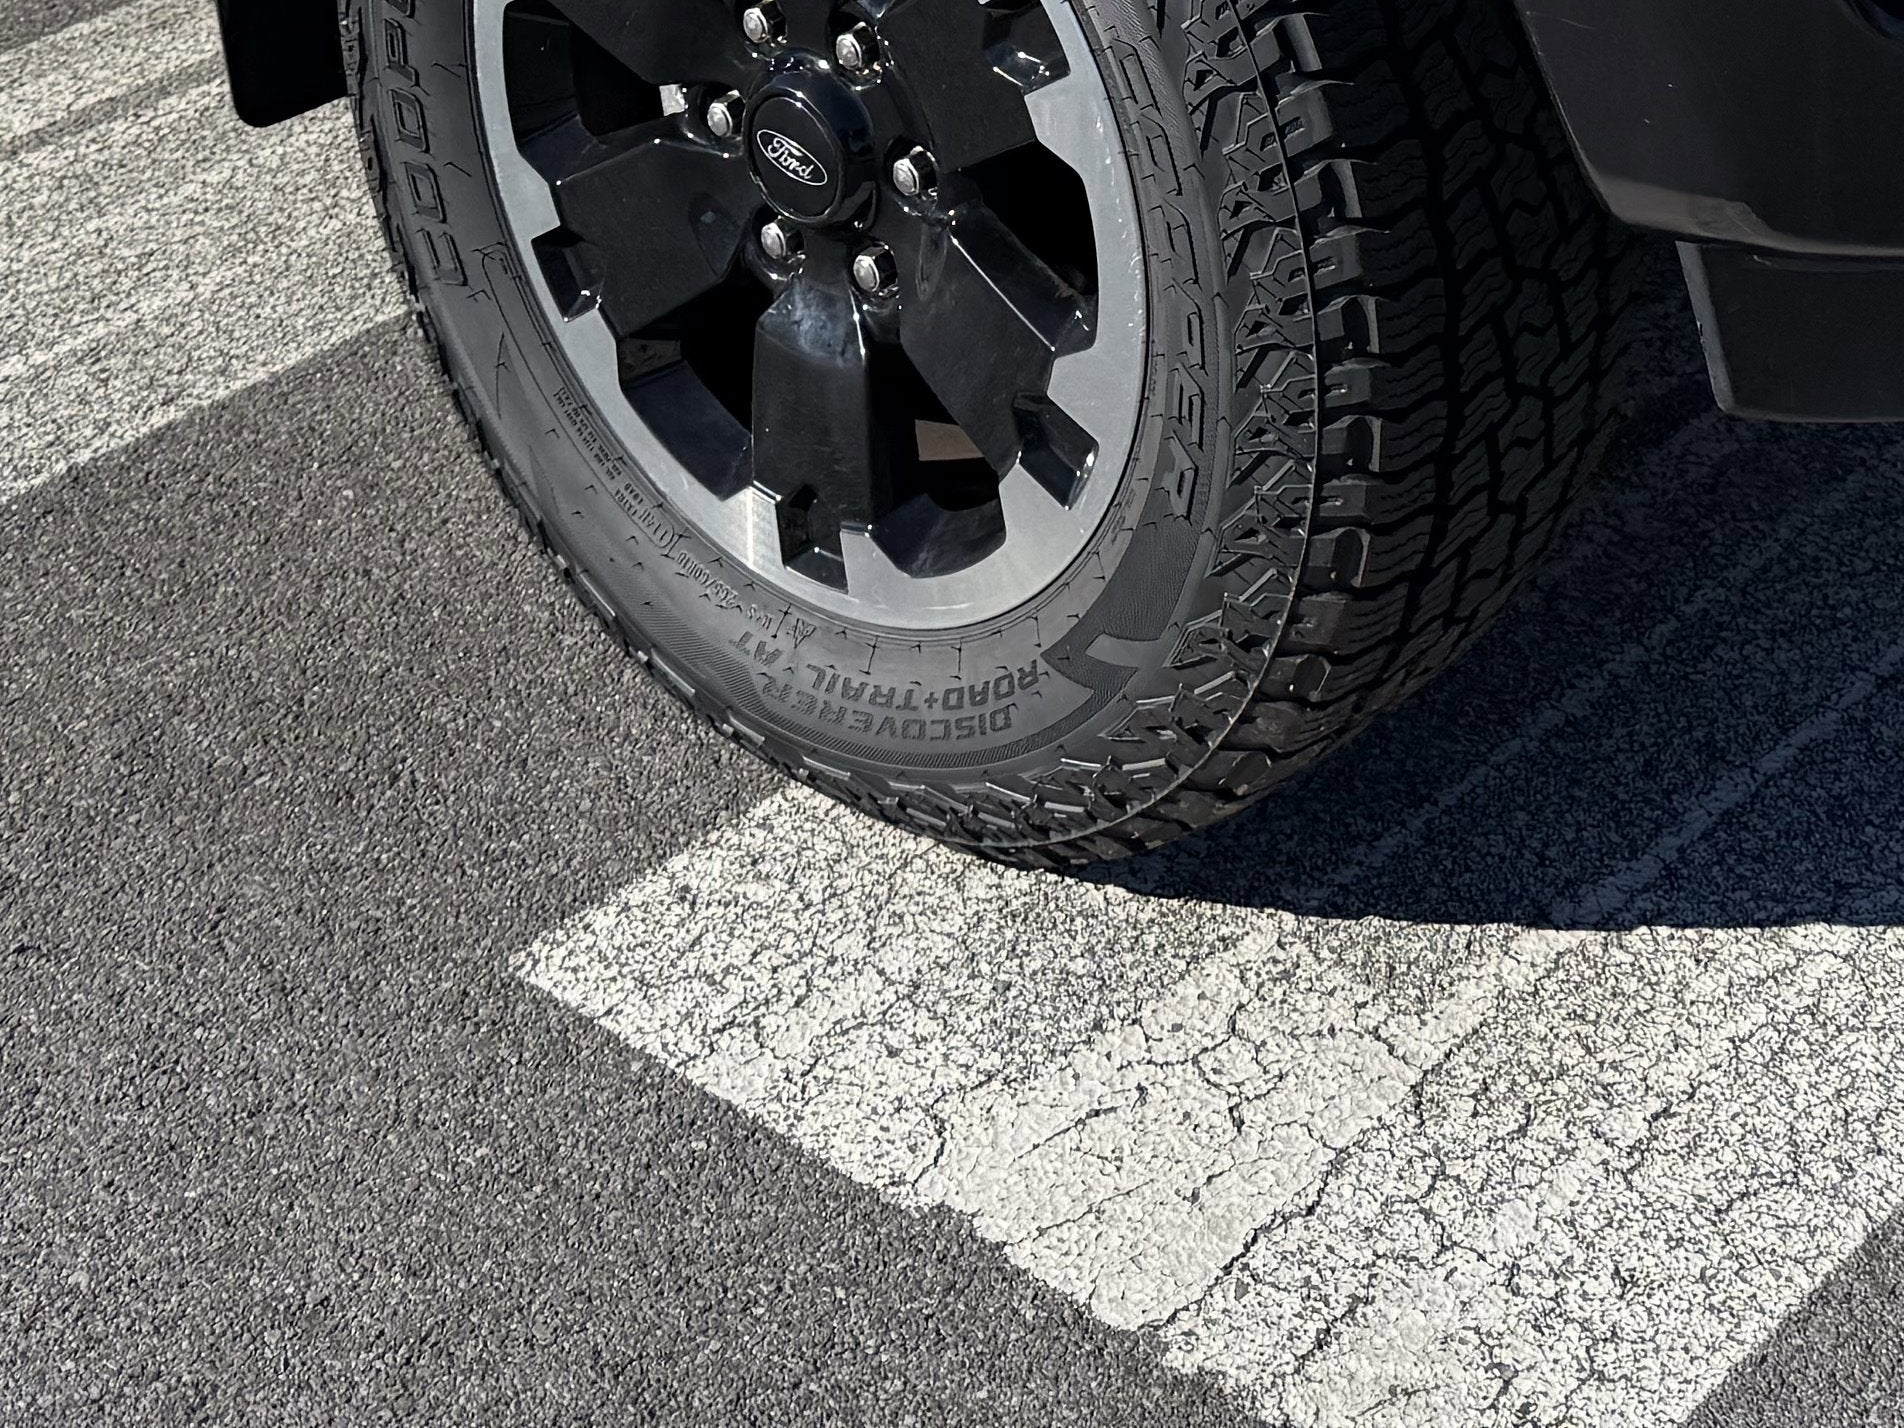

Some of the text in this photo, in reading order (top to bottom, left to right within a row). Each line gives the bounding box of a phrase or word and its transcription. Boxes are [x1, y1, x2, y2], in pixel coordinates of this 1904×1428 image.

[767, 136, 815, 180] Ford
[761, 675, 1015, 743] DISCOVERER
[805, 659, 1039, 713] ROAD+TRAIL
